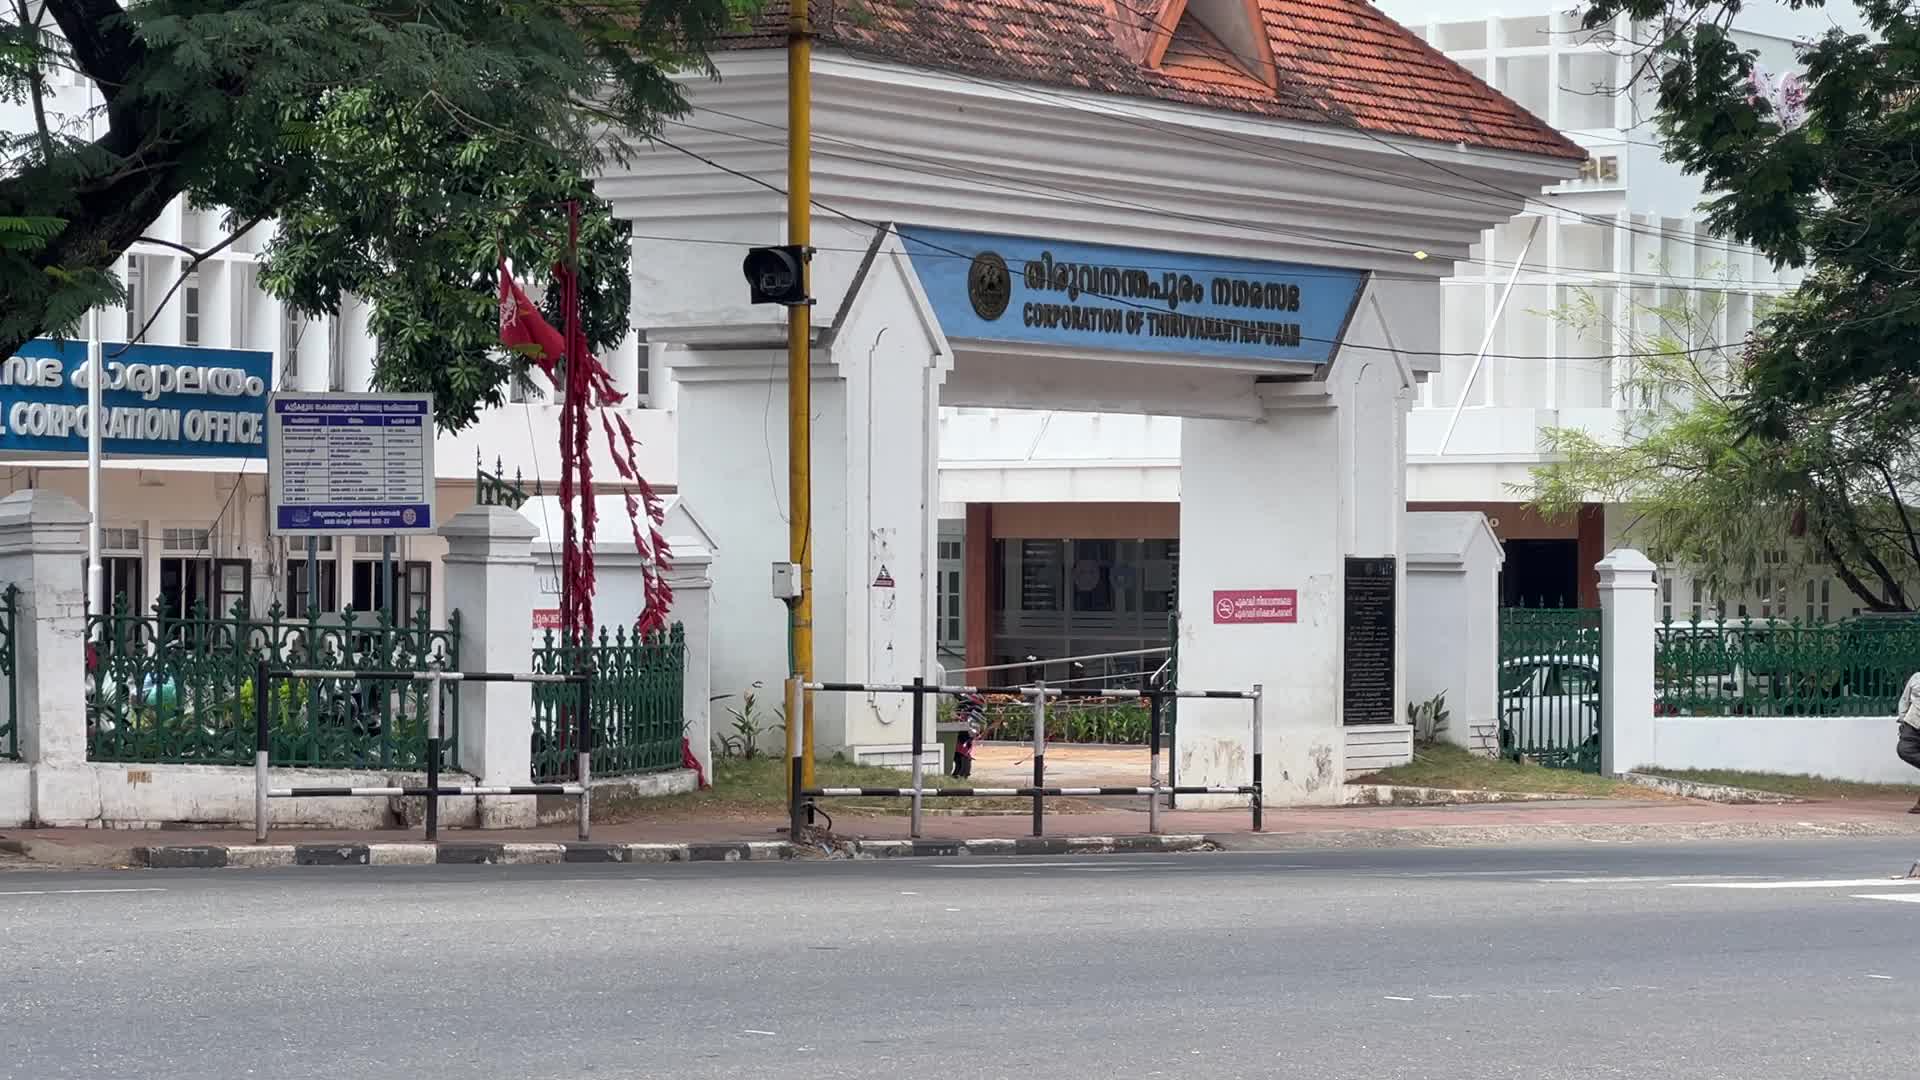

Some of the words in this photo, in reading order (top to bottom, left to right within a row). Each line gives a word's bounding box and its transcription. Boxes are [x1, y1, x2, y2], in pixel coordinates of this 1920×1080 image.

[1023, 250, 1205, 310] തിരുവനന്തപുരം
[1210, 276, 1302, 313] നഗരസഭ
[1023, 302, 1123, 334] CORPORATION
[1125, 311, 1145, 335] OF
[9, 401, 181, 441] CORPORATION
[183, 410, 263, 444] OFFICE
